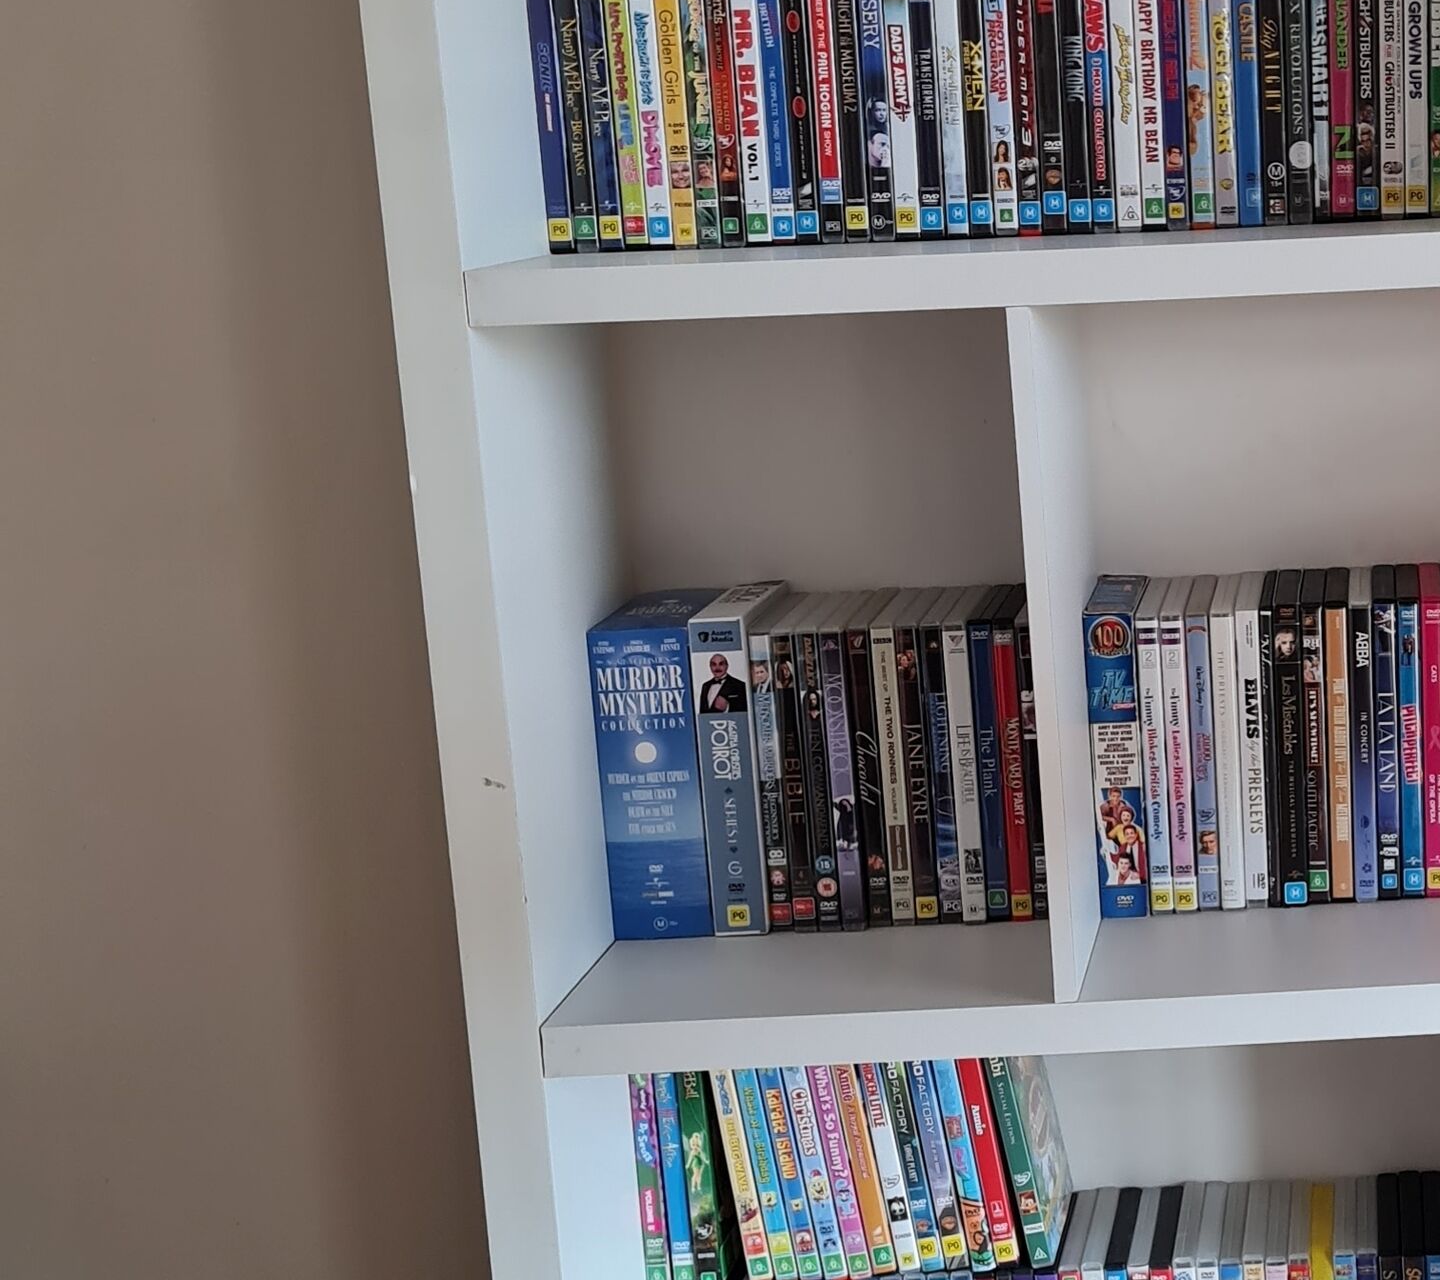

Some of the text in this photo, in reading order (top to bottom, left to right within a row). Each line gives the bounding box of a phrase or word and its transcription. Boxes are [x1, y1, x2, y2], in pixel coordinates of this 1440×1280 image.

[658, 9, 676, 65] Golden
[889, 26, 910, 111] DAD'S ARMY
[1408, 0, 1423, 100] GROWN UPS
[733, 10, 760, 137] MR. BEAN
[817, 50, 832, 157] PAUL HOGAN SHOW
[918, 48, 935, 121] TRANSFORMERS
[1264, 51, 1282, 113] NIGHT
[1290, 23, 1305, 135] REVOLUTIONS
[1384, 61, 1396, 139] GHOSTBUSTERS
[1021, 128, 1033, 147] 3
[1093, 108, 1107, 181] COLLECTION
[1144, 106, 1158, 125] MR
[1145, 129, 1160, 163] BEAN
[851, 213, 863, 223] PG
[900, 213, 913, 222] PG
[1410, 191, 1423, 201] PG
[553, 225, 566, 235] PG
[1095, 627, 1124, 649] 100
[597, 664, 685, 692] MURDER
[599, 689, 686, 717] MYSTERY
[1355, 631, 1370, 764] ABBA IN CONCERT
[601, 717, 686, 734] COLLECTION
[709, 720, 731, 781] POIROT
[1244, 678, 1264, 835] ELVIS PRESLEYS
[1378, 692, 1396, 793] LA LA LAND
[784, 758, 804, 824] BIBLE
[855, 730, 882, 806] Chocolat
[903, 723, 929, 824] JANE EYRE
[980, 726, 997, 798] The Plank
[1012, 792, 1024, 816] PART
[1150, 766, 1163, 842] British Comedy
[1173, 766, 1188, 842] British Comedy
[1156, 894, 1168, 904] PG
[823, 1112, 848, 1178] So Funny?
